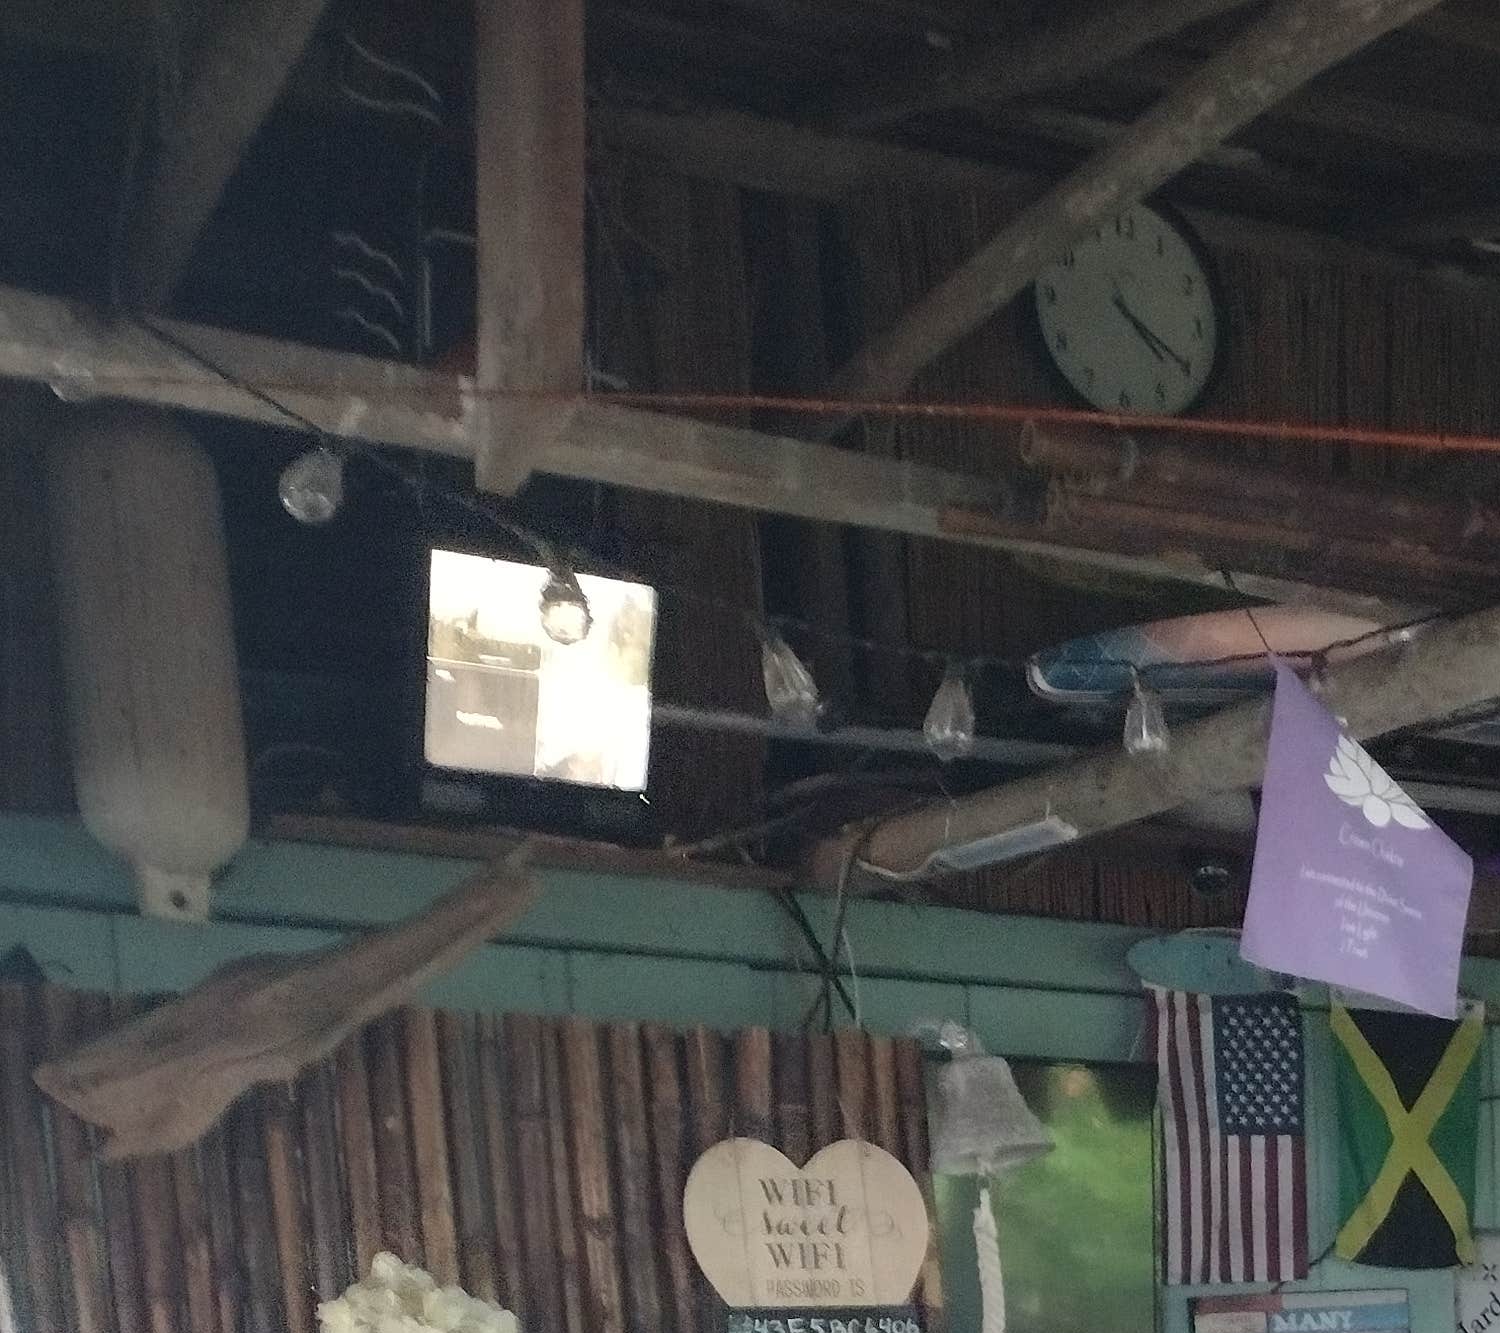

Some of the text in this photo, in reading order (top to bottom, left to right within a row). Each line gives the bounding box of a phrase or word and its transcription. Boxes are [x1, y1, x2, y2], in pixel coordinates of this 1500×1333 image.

[758, 1177, 838, 1206] WIFI
[765, 1241, 849, 1270] WIFI
[766, 1278, 866, 1299] PASSWORD IS
[1270, 1310, 1353, 1333] MANY
